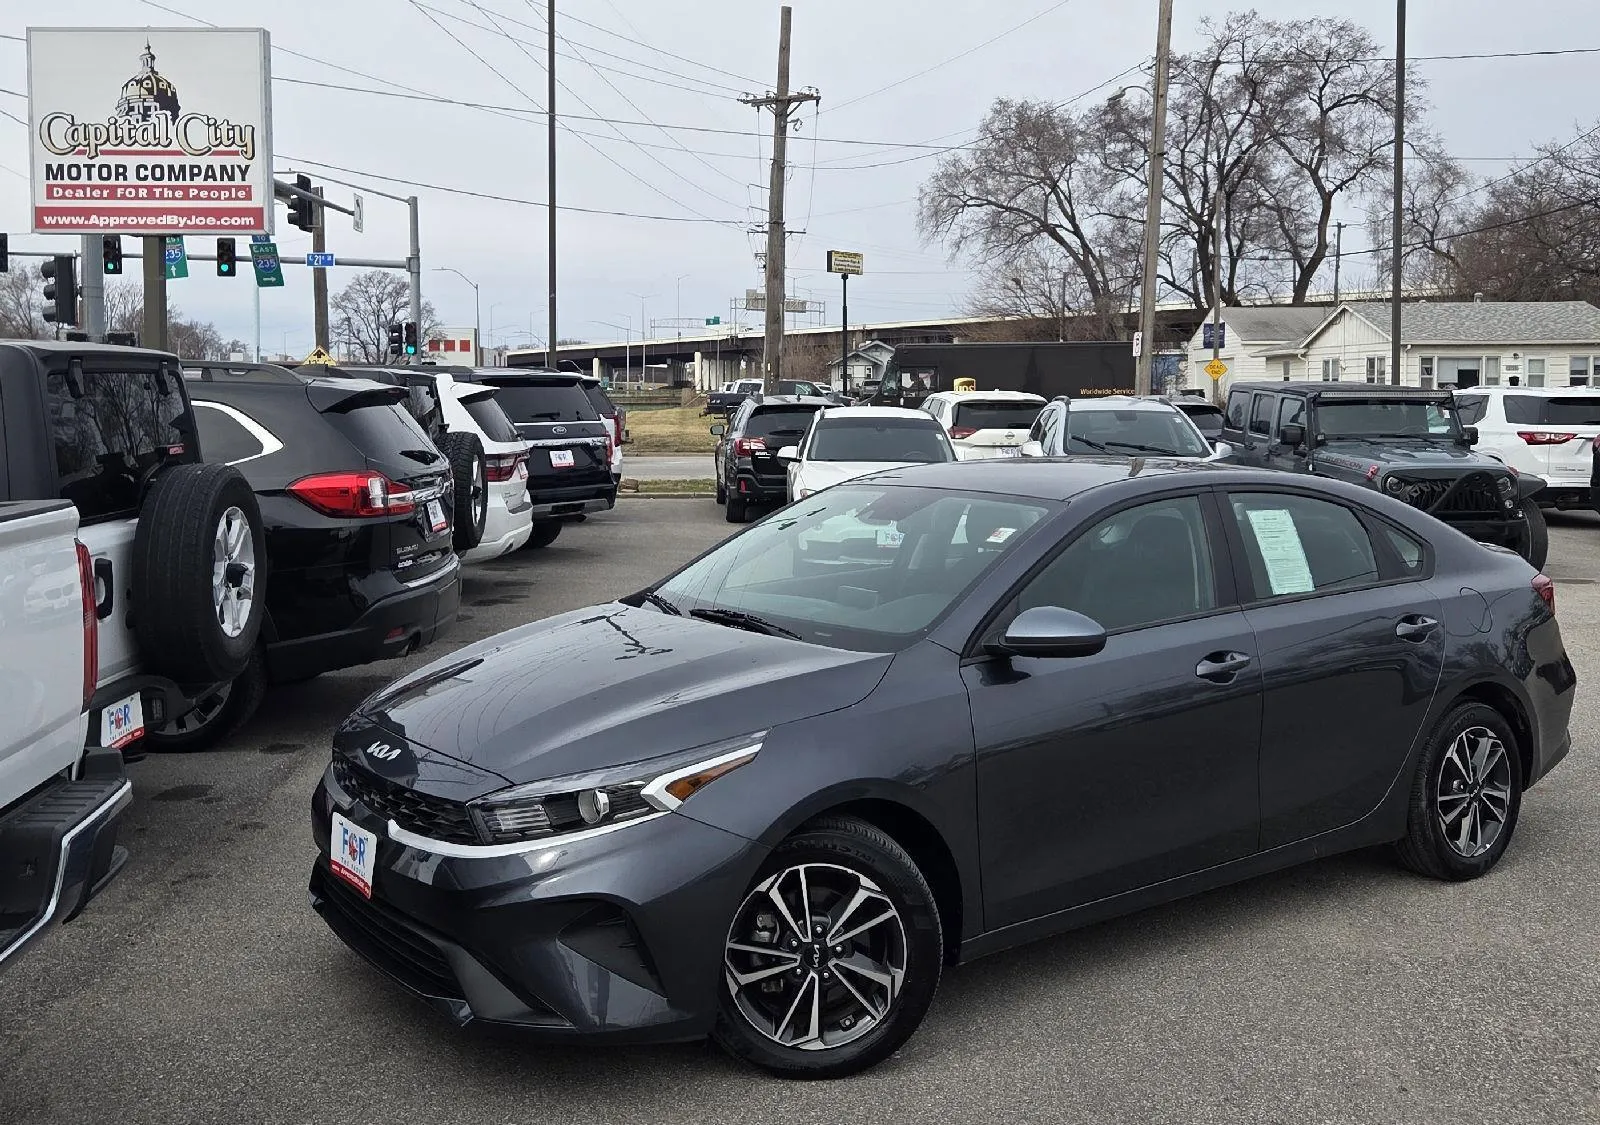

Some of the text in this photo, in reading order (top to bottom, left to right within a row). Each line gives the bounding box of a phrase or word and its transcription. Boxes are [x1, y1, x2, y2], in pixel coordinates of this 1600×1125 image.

[39, 112, 256, 160] Capital City
[45, 163, 251, 182] MOTOR COMPANY
[53, 187, 247, 200] Dealer FOR The People
[43, 214, 255, 228] www.ApprovedByJoe.com
[252, 245, 274, 253] EAST
[257, 259, 277, 268] 235
[342, 827, 366, 868] FOR
